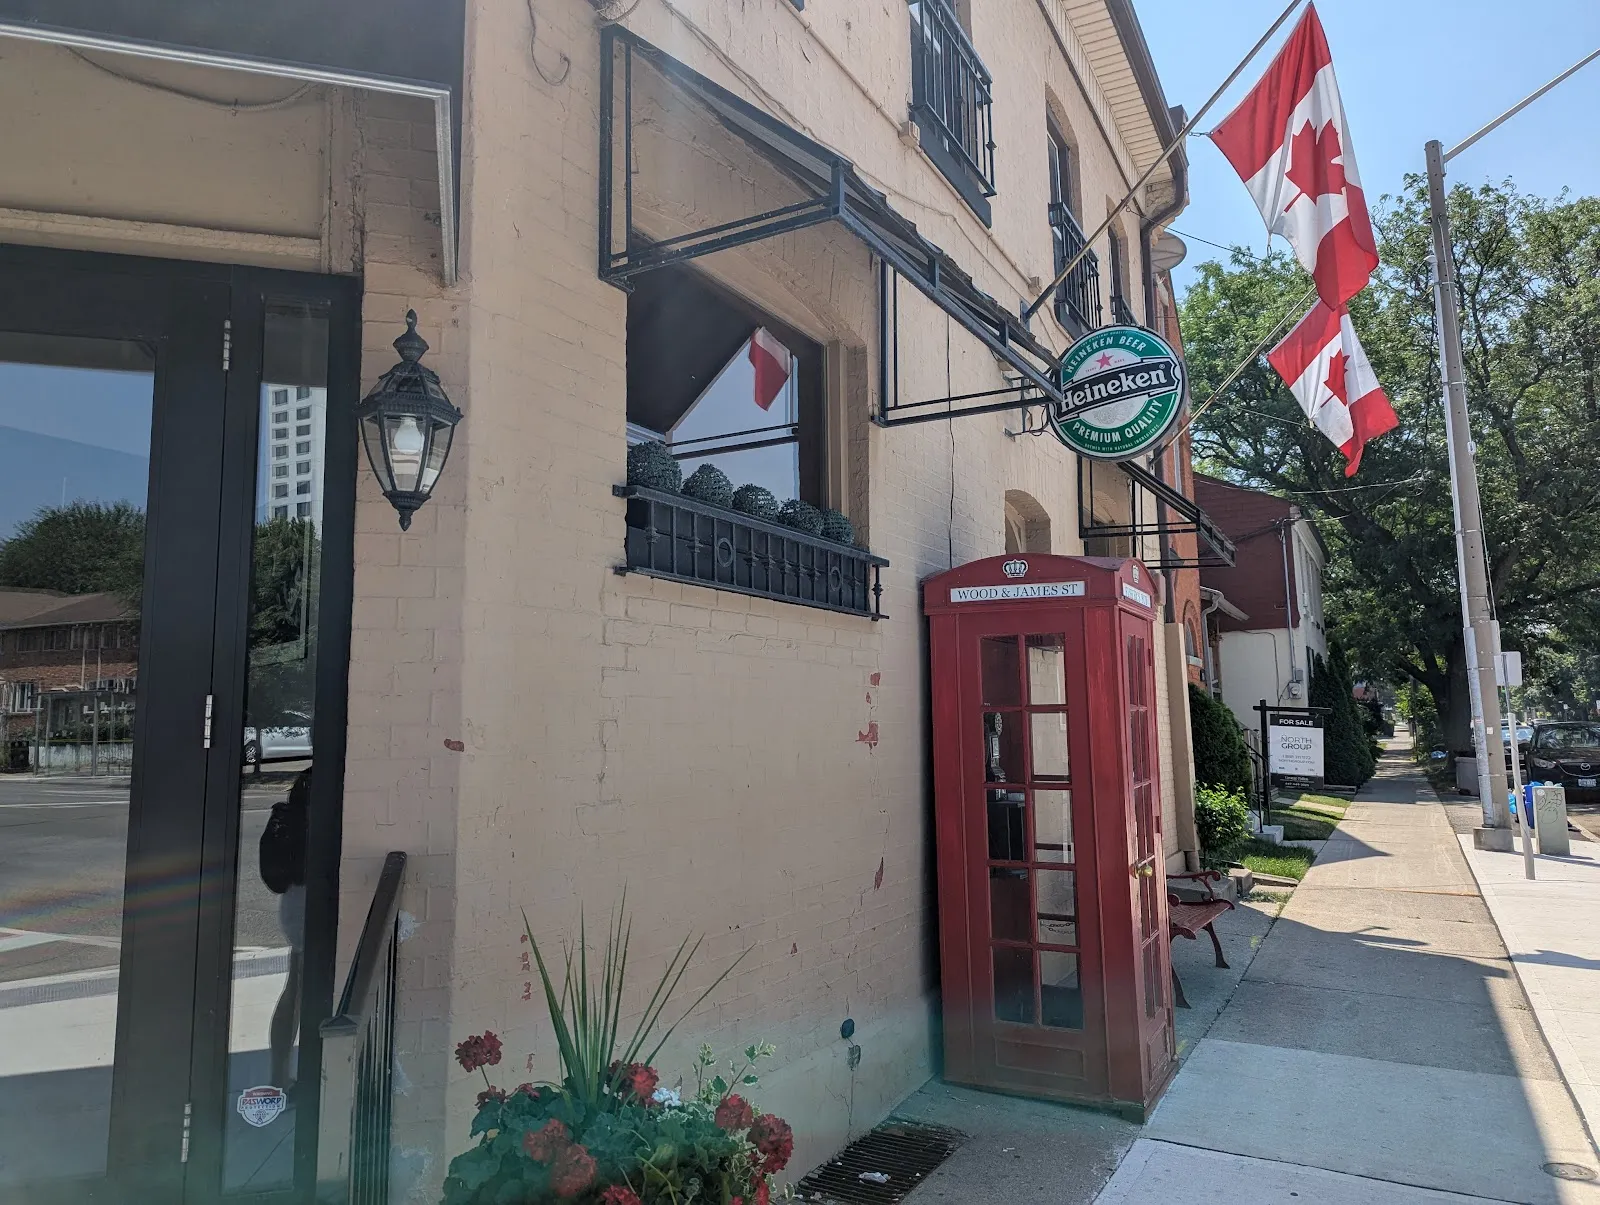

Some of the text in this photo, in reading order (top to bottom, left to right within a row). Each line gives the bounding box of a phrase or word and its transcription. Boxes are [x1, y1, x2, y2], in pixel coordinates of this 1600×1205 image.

[1066, 335, 1147, 374] HEINEKEN BEER
[1060, 368, 1168, 413] Heineken
[1072, 399, 1163, 443] PREMIUM QUALITY
[957, 583, 1078, 600] WOOD & JAMES ST
[1281, 736, 1312, 744] NORTH
[1281, 742, 1312, 750] GROUP
